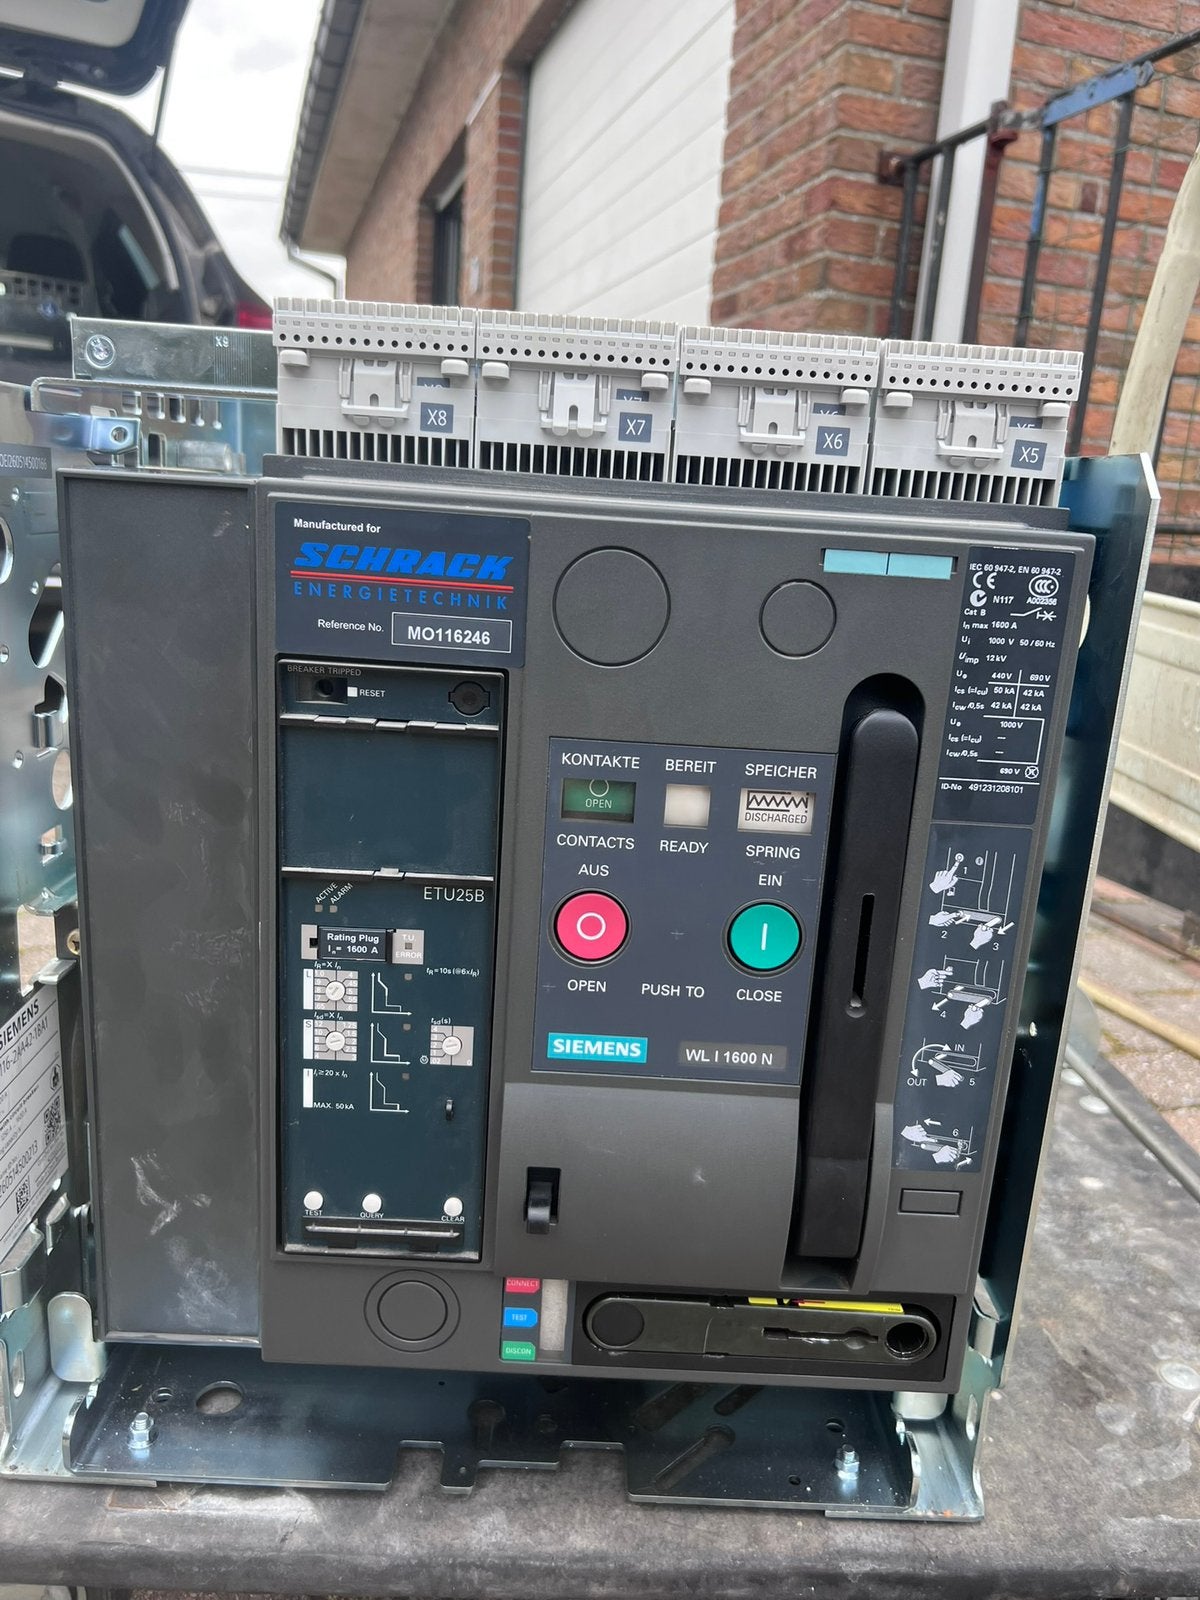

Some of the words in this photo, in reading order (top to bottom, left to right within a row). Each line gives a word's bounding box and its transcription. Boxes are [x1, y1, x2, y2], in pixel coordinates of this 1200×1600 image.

[215, 335, 229, 348] X9
[427, 409, 447, 427] X8
[625, 418, 646, 436] X7
[822, 432, 843, 450] X6
[1019, 446, 1040, 463] X5
[293, 518, 364, 532] Manufactured
[366, 523, 381, 534] for
[294, 542, 514, 581] SCHRACK
[969, 563, 983, 571] IEC
[1018, 566, 1030, 574] EN
[294, 581, 507, 610] ENERGIETECHNIK
[992, 595, 1014, 604] N117
[964, 608, 977, 616] Cat
[317, 618, 366, 632] Reference
[368, 622, 384, 633] No.
[991, 621, 1009, 629] 1600
[407, 625, 490, 645] MO116246
[988, 637, 1006, 645] 1000
[1045, 640, 1056, 648] Hz
[287, 664, 325, 674] BREAKER
[328, 667, 362, 677] TRIPPED
[359, 689, 385, 698] RESET
[1004, 687, 1015, 695] kA
[1022, 689, 1032, 697] 42
[1033, 689, 1045, 697] kA
[1001, 702, 1012, 710] kA
[1020, 703, 1030, 711] 42
[1031, 704, 1042, 712] kA
[561, 752, 640, 769] KONTAKTE
[665, 758, 717, 773] BEREIT
[745, 763, 817, 779] SPEICHER
[940, 783, 962, 791] ID-No
[585, 798, 612, 809] OPEN
[744, 812, 808, 824] DISCHARGED
[557, 833, 635, 850] CONTACTS
[659, 839, 709, 854] READY
[745, 844, 801, 859] SPRING
[578, 863, 610, 877] AUS
[963, 867, 968, 875] 1
[758, 874, 782, 887] EIN
[315, 882, 339, 903] ACTIVE
[329, 883, 354, 904] ALARM
[423, 886, 485, 903] ETU25B
[327, 933, 356, 944] Rating
[359, 934, 379, 944] Plug
[401, 934, 416, 942] T.U.
[941, 930, 948, 939] 2
[371, 946, 378, 954] A
[992, 942, 1000, 951] 3
[567, 979, 607, 993] OPEN
[641, 983, 680, 997] PUSH
[686, 986, 705, 998] TO
[736, 988, 783, 1002] CLOSE
[305, 1020, 312, 1028] S
[553, 1038, 641, 1057] SIEMENS
[954, 1044, 965, 1052] IN
[686, 1049, 710, 1062] WL
[714, 1051, 719, 1063] I
[723, 1051, 757, 1064] 1600
[761, 1052, 773, 1065] N
[907, 1077, 927, 1087] OUT
[969, 1078, 975, 1086] 5
[952, 1129, 959, 1137] 6
[506, 1279, 539, 1287] CONNECT
[505, 1347, 531, 1355] DISCON
